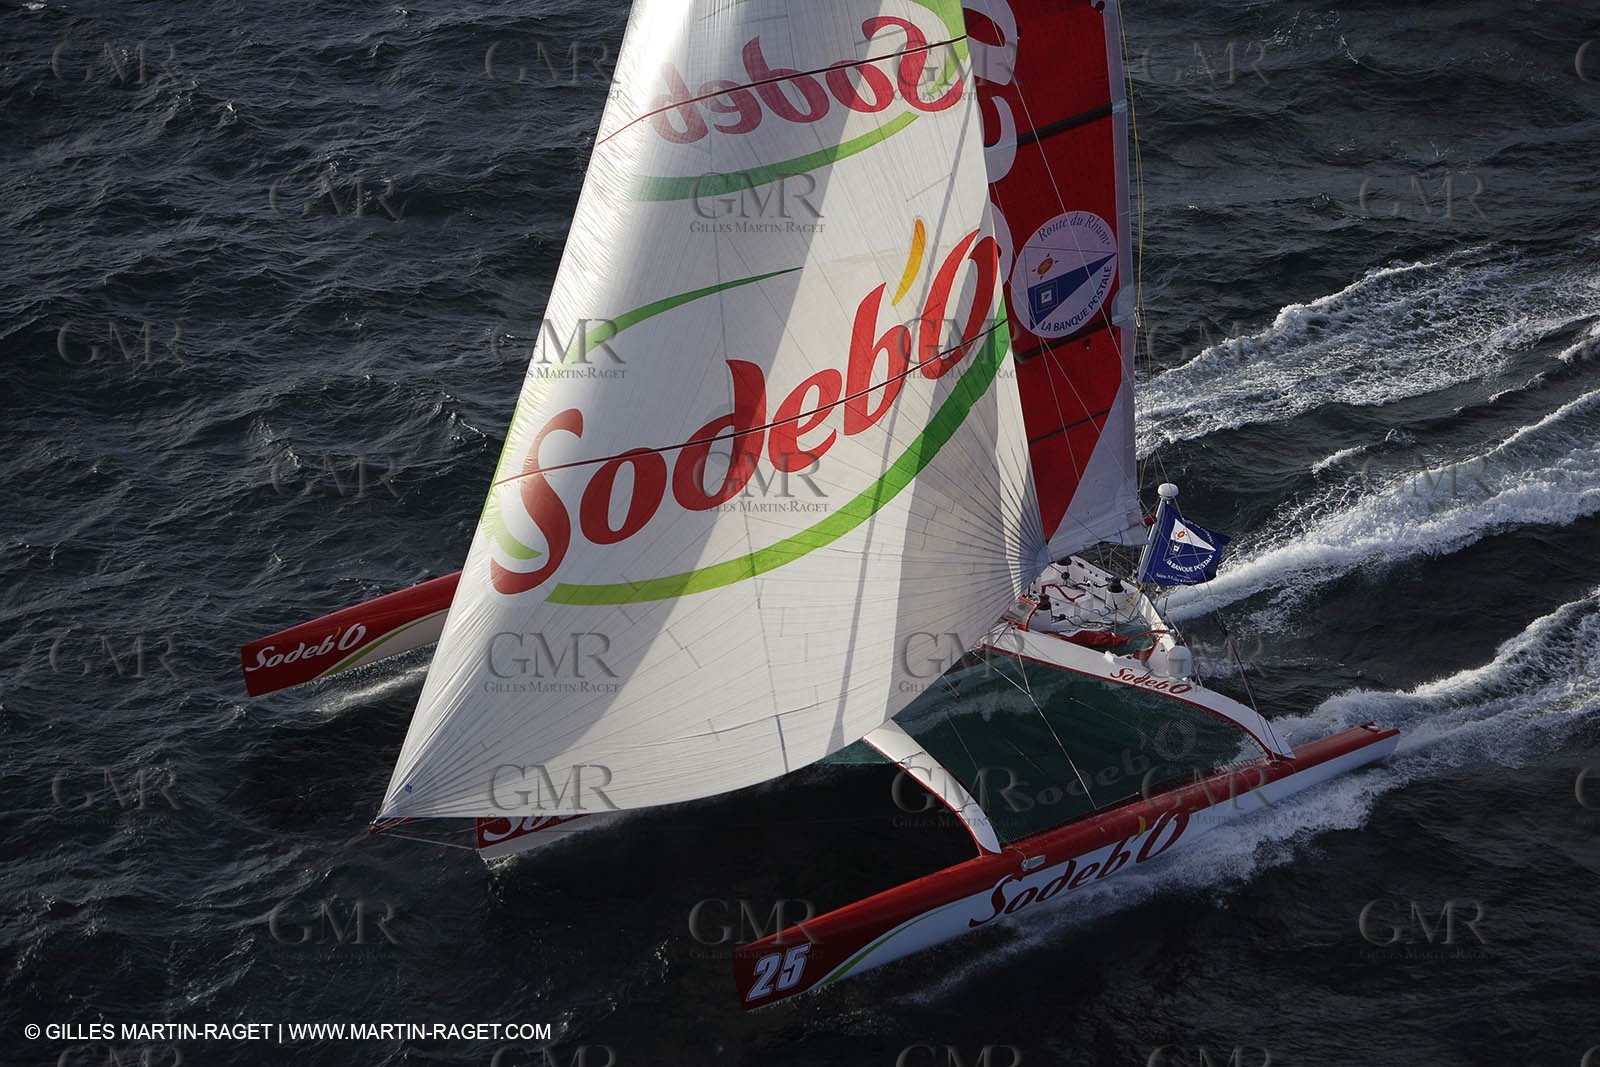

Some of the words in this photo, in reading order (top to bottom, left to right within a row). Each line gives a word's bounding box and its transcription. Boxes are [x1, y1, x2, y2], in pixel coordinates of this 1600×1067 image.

[1038, 218, 1069, 241] Route
[1070, 212, 1083, 226] du
[1041, 322, 1052, 332] LA
[1053, 310, 1089, 332] BANQUE
[1088, 265, 1113, 310] POSTALE
[490, 218, 1001, 595] Sodeb'O
[745, 943, 812, 1002] 25
